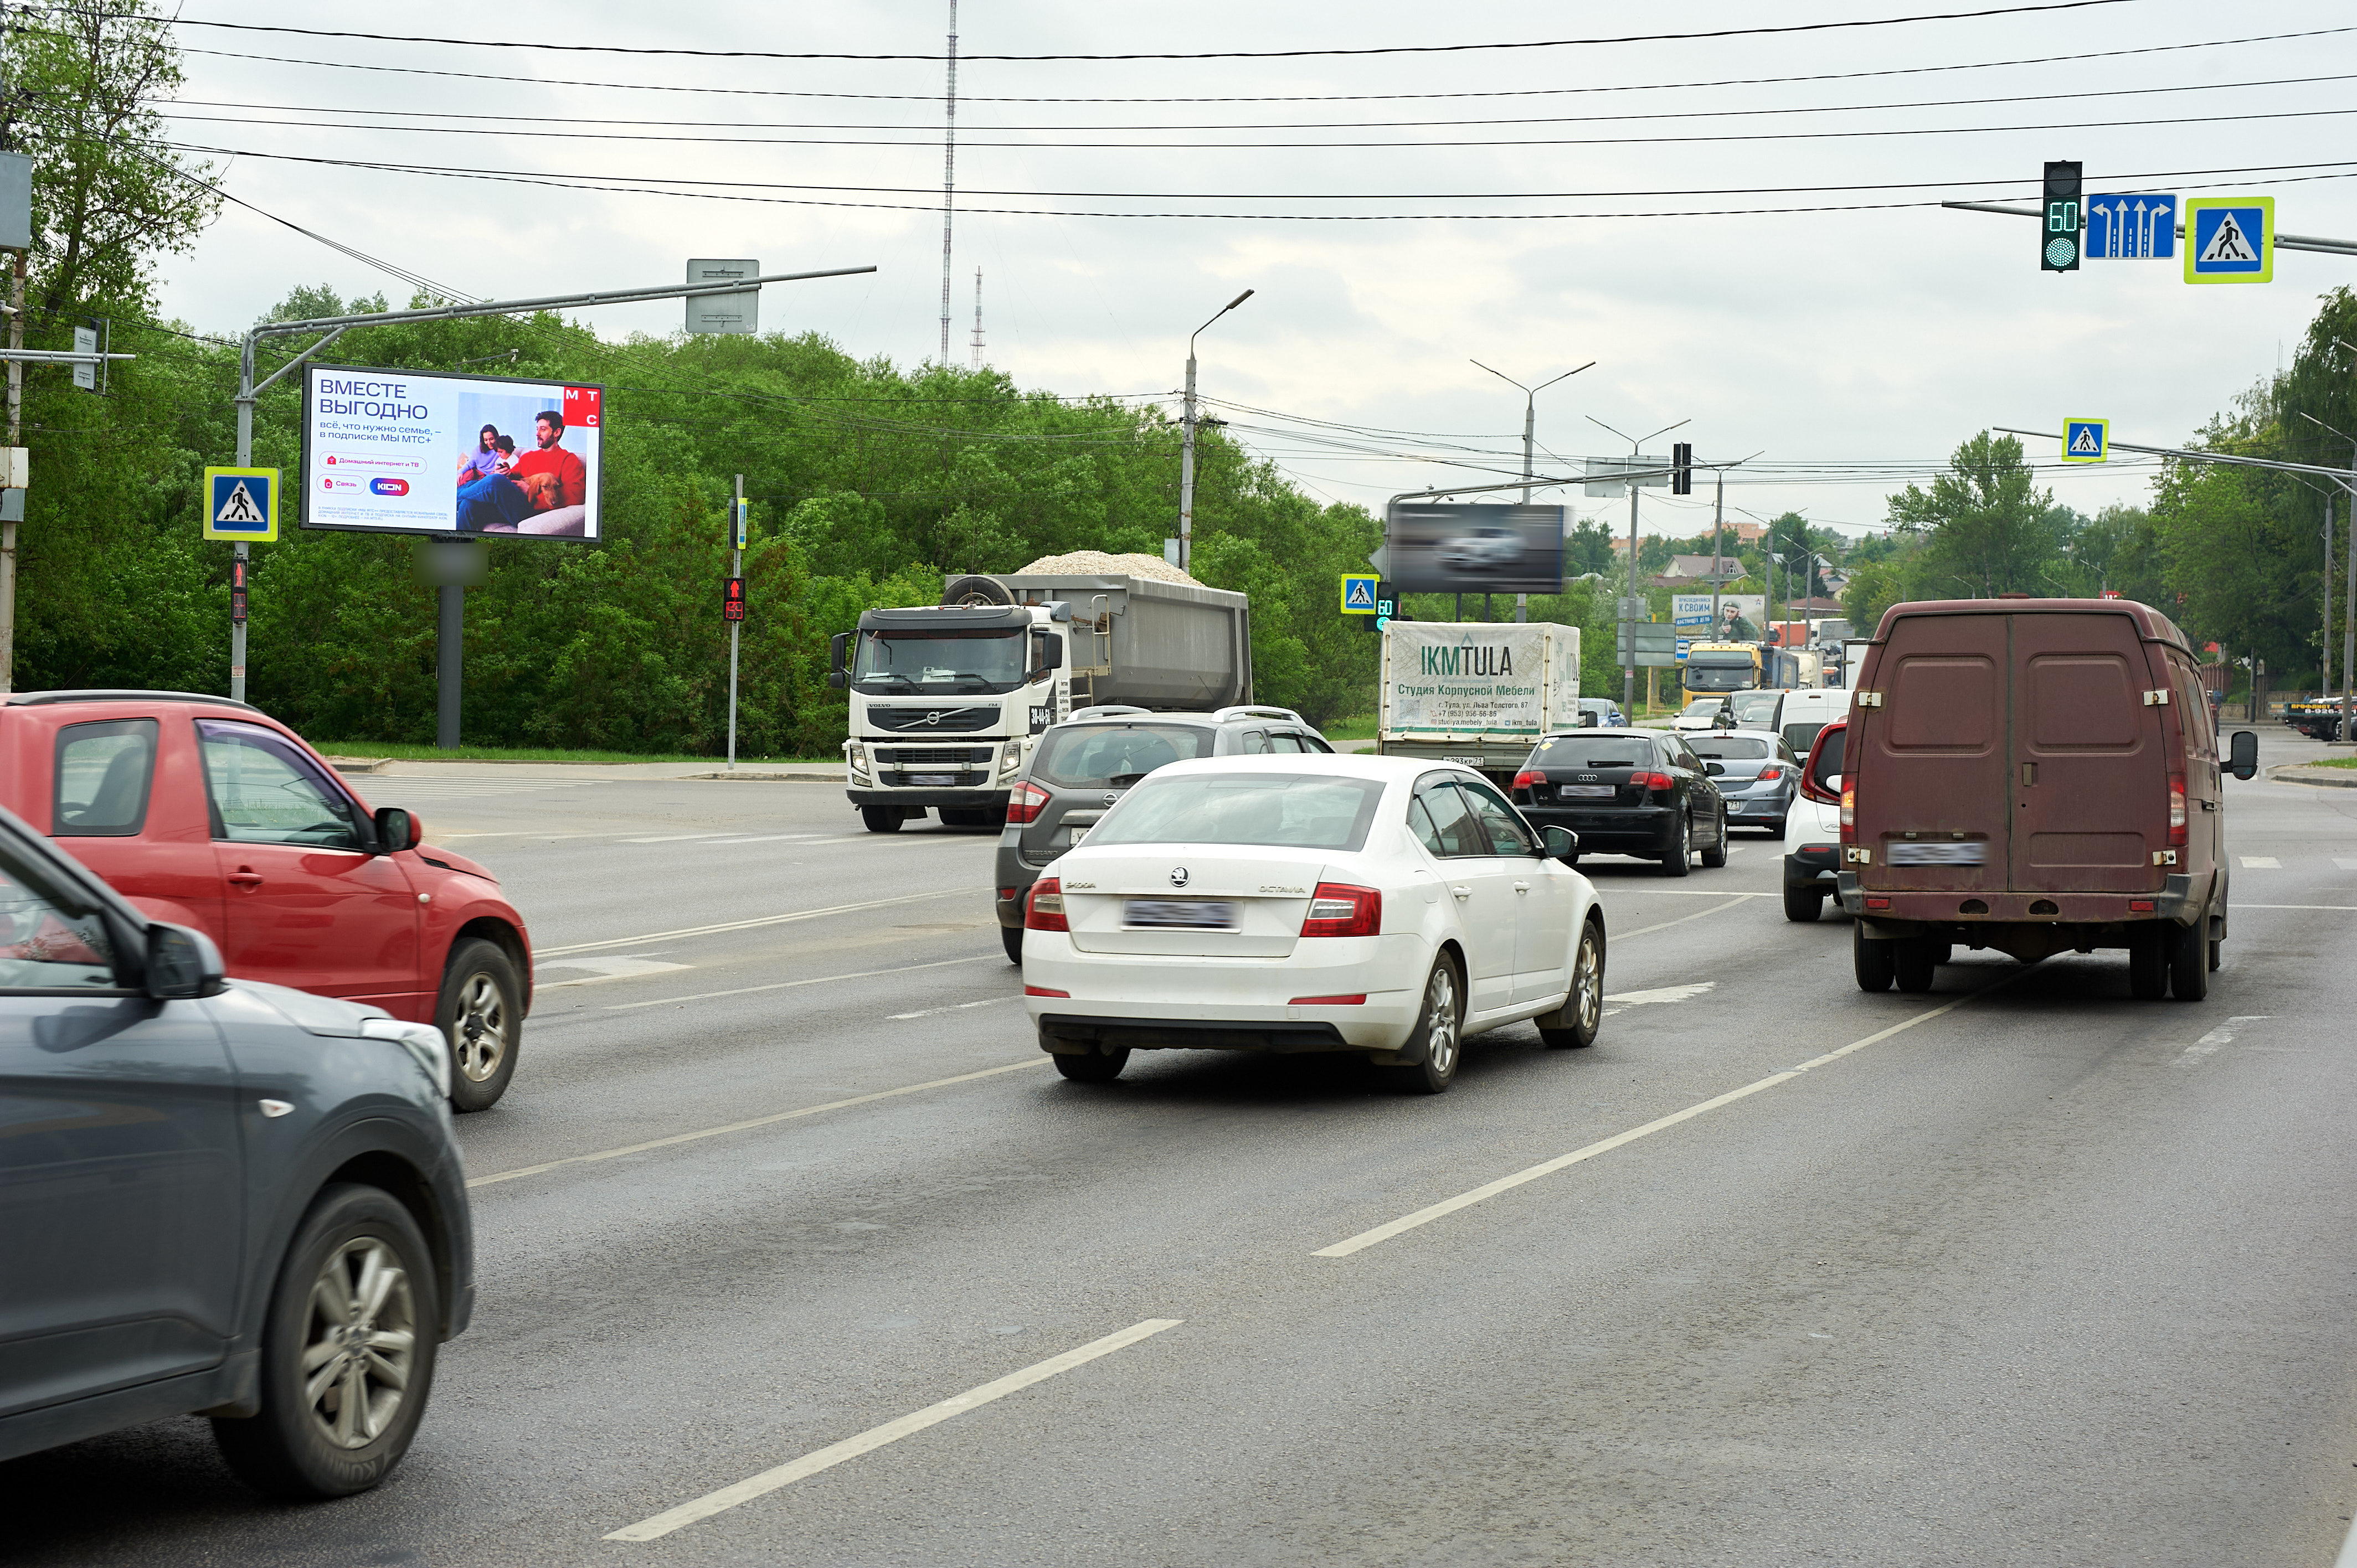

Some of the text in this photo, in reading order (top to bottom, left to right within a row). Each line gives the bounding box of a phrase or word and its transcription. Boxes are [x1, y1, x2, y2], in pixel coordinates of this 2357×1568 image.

[2049, 202, 2077, 231] 60
[320, 379, 407, 399] ВМЕСТЕ
[320, 399, 428, 421] ВЫГОДНО
[320, 421, 341, 430] всё,
[399, 427, 433, 436] семье,
[381, 434, 399, 442] МЫ
[402, 435, 431, 443] МТС+
[377, 483, 402, 491] KION
[1378, 600, 1393, 616] 60
[1679, 603, 1710, 612] К СВОИМ
[1421, 646, 1513, 677] IKMTULA
[1398, 684, 1535, 697] Студия Корпусной Мебели
[1031, 708, 1051, 725] 38-44-54
[1258, 885, 1306, 893] OCTAVIA
